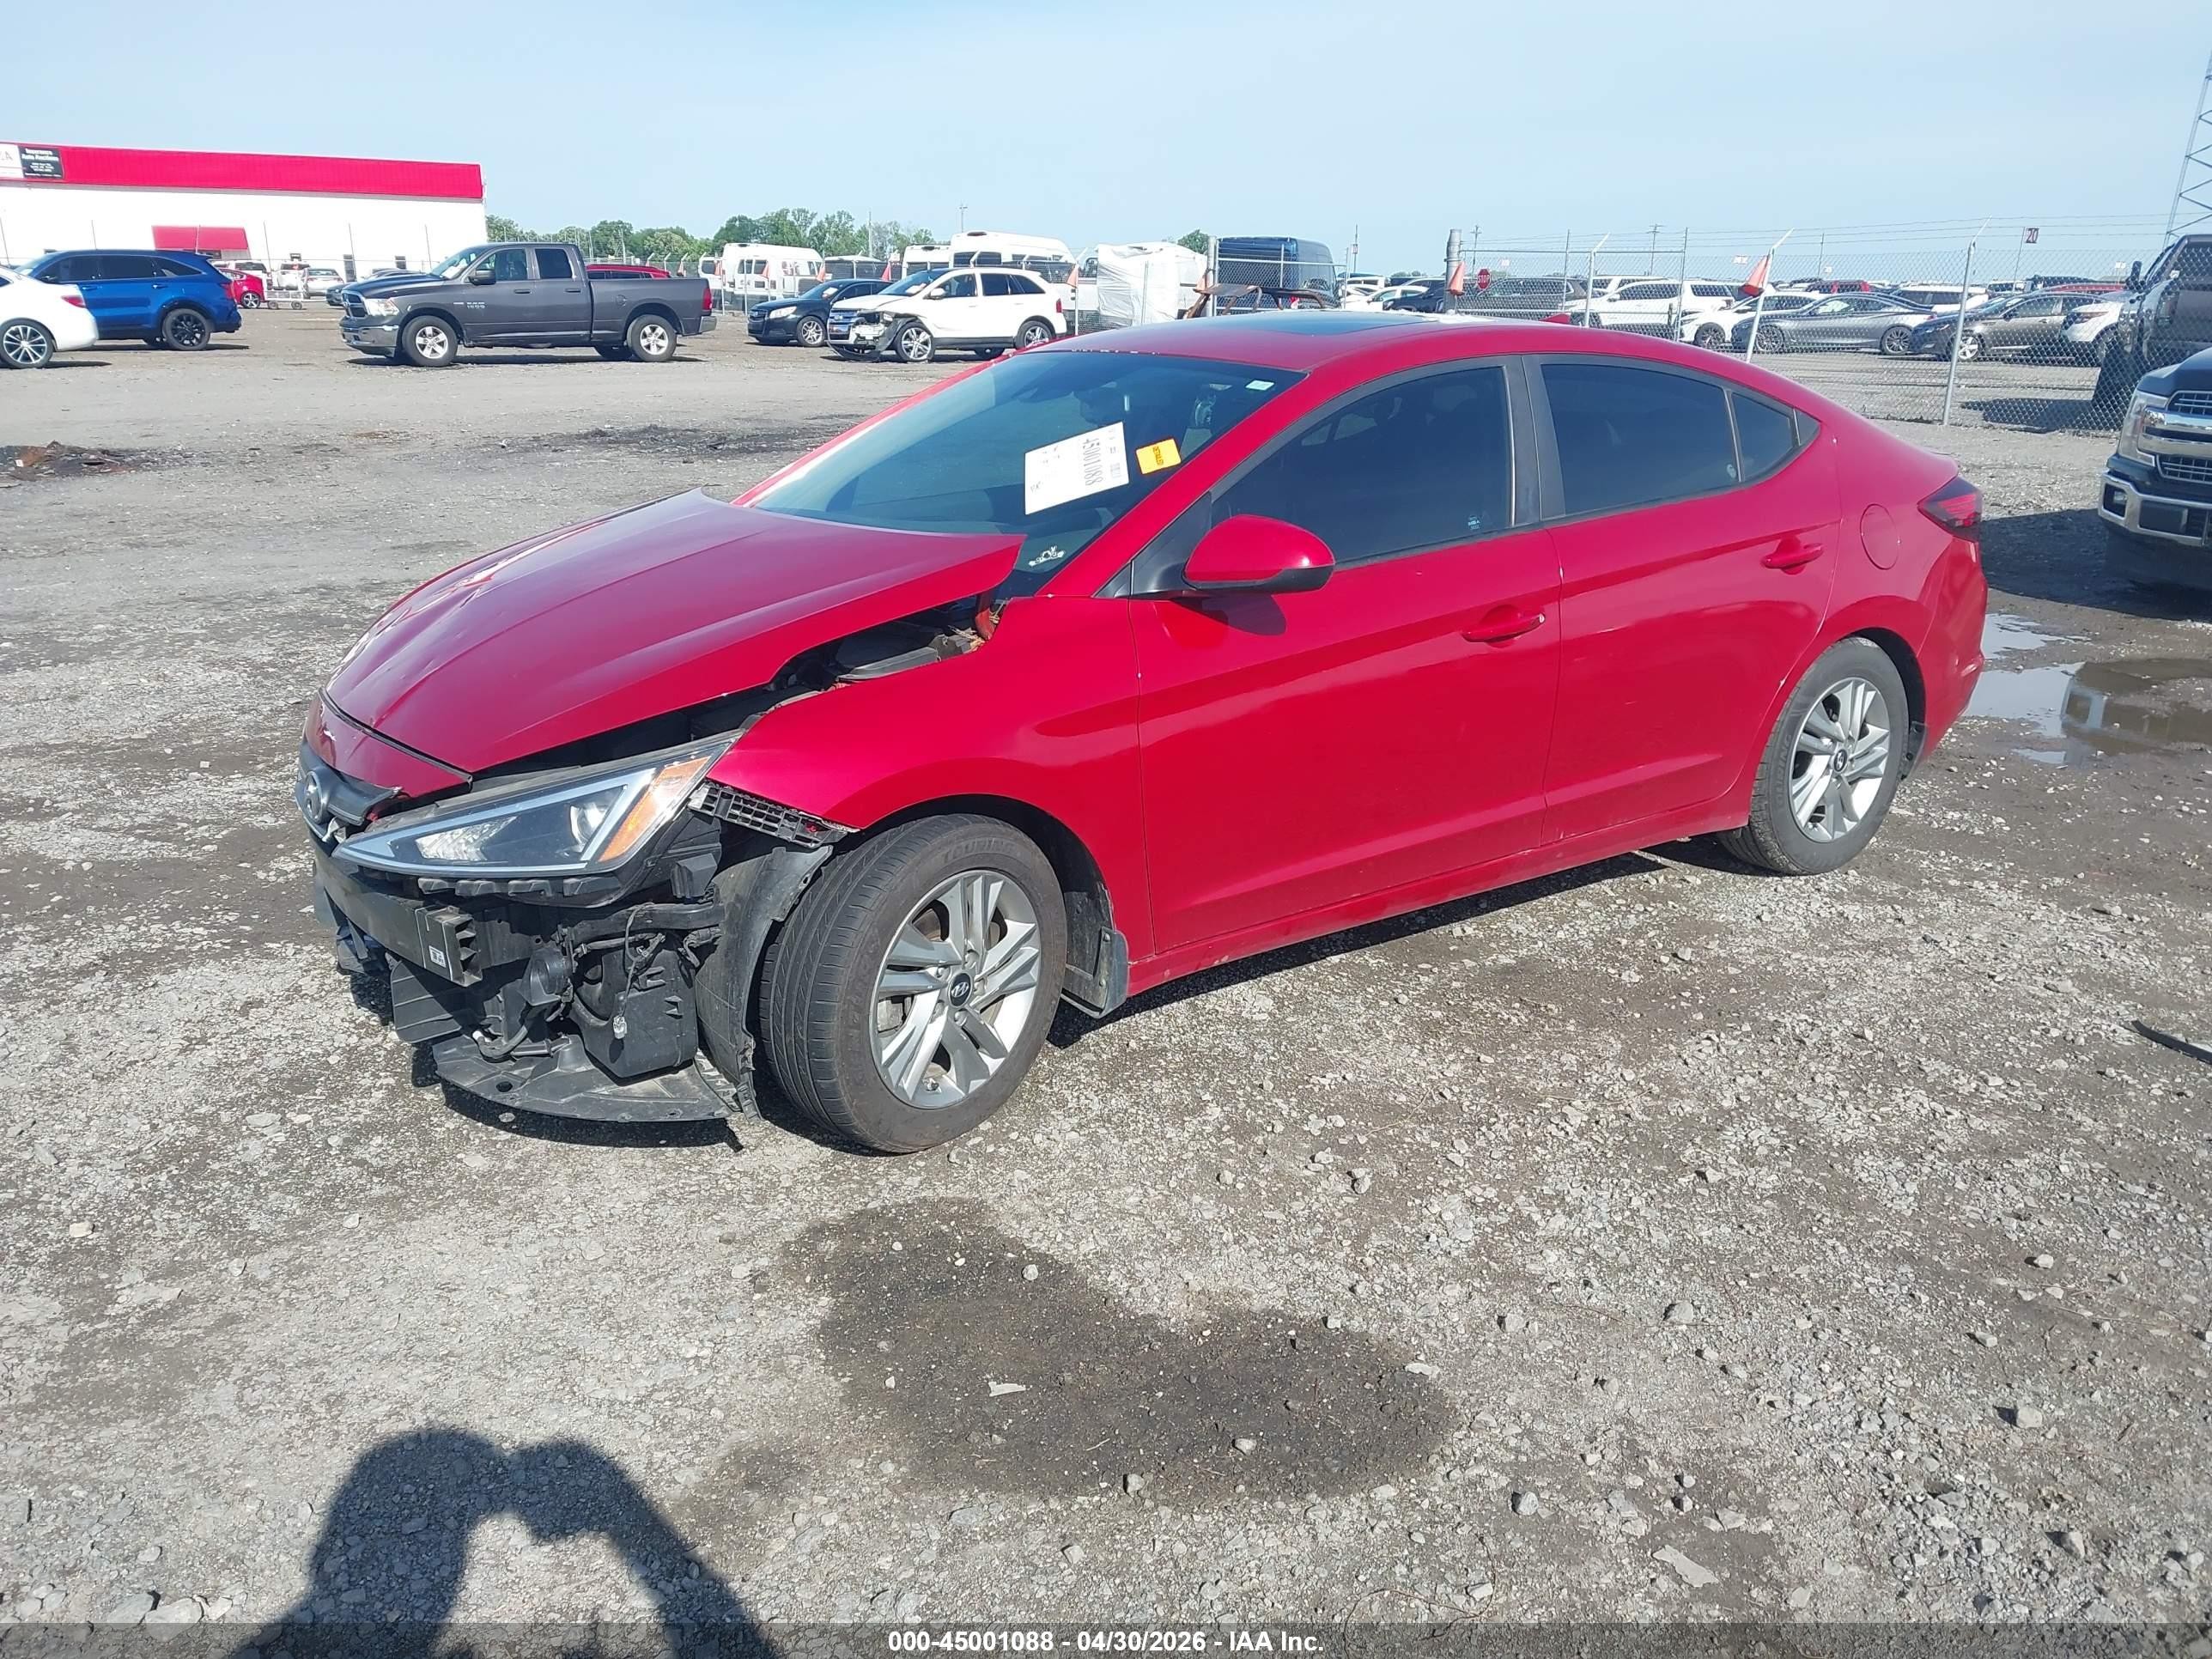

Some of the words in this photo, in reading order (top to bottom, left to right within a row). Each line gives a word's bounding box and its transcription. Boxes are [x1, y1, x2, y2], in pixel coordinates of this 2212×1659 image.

[2026, 228, 2039, 244] 20
[1478, 274, 1490, 283] STOP
[1082, 438, 1103, 486] 45001088
